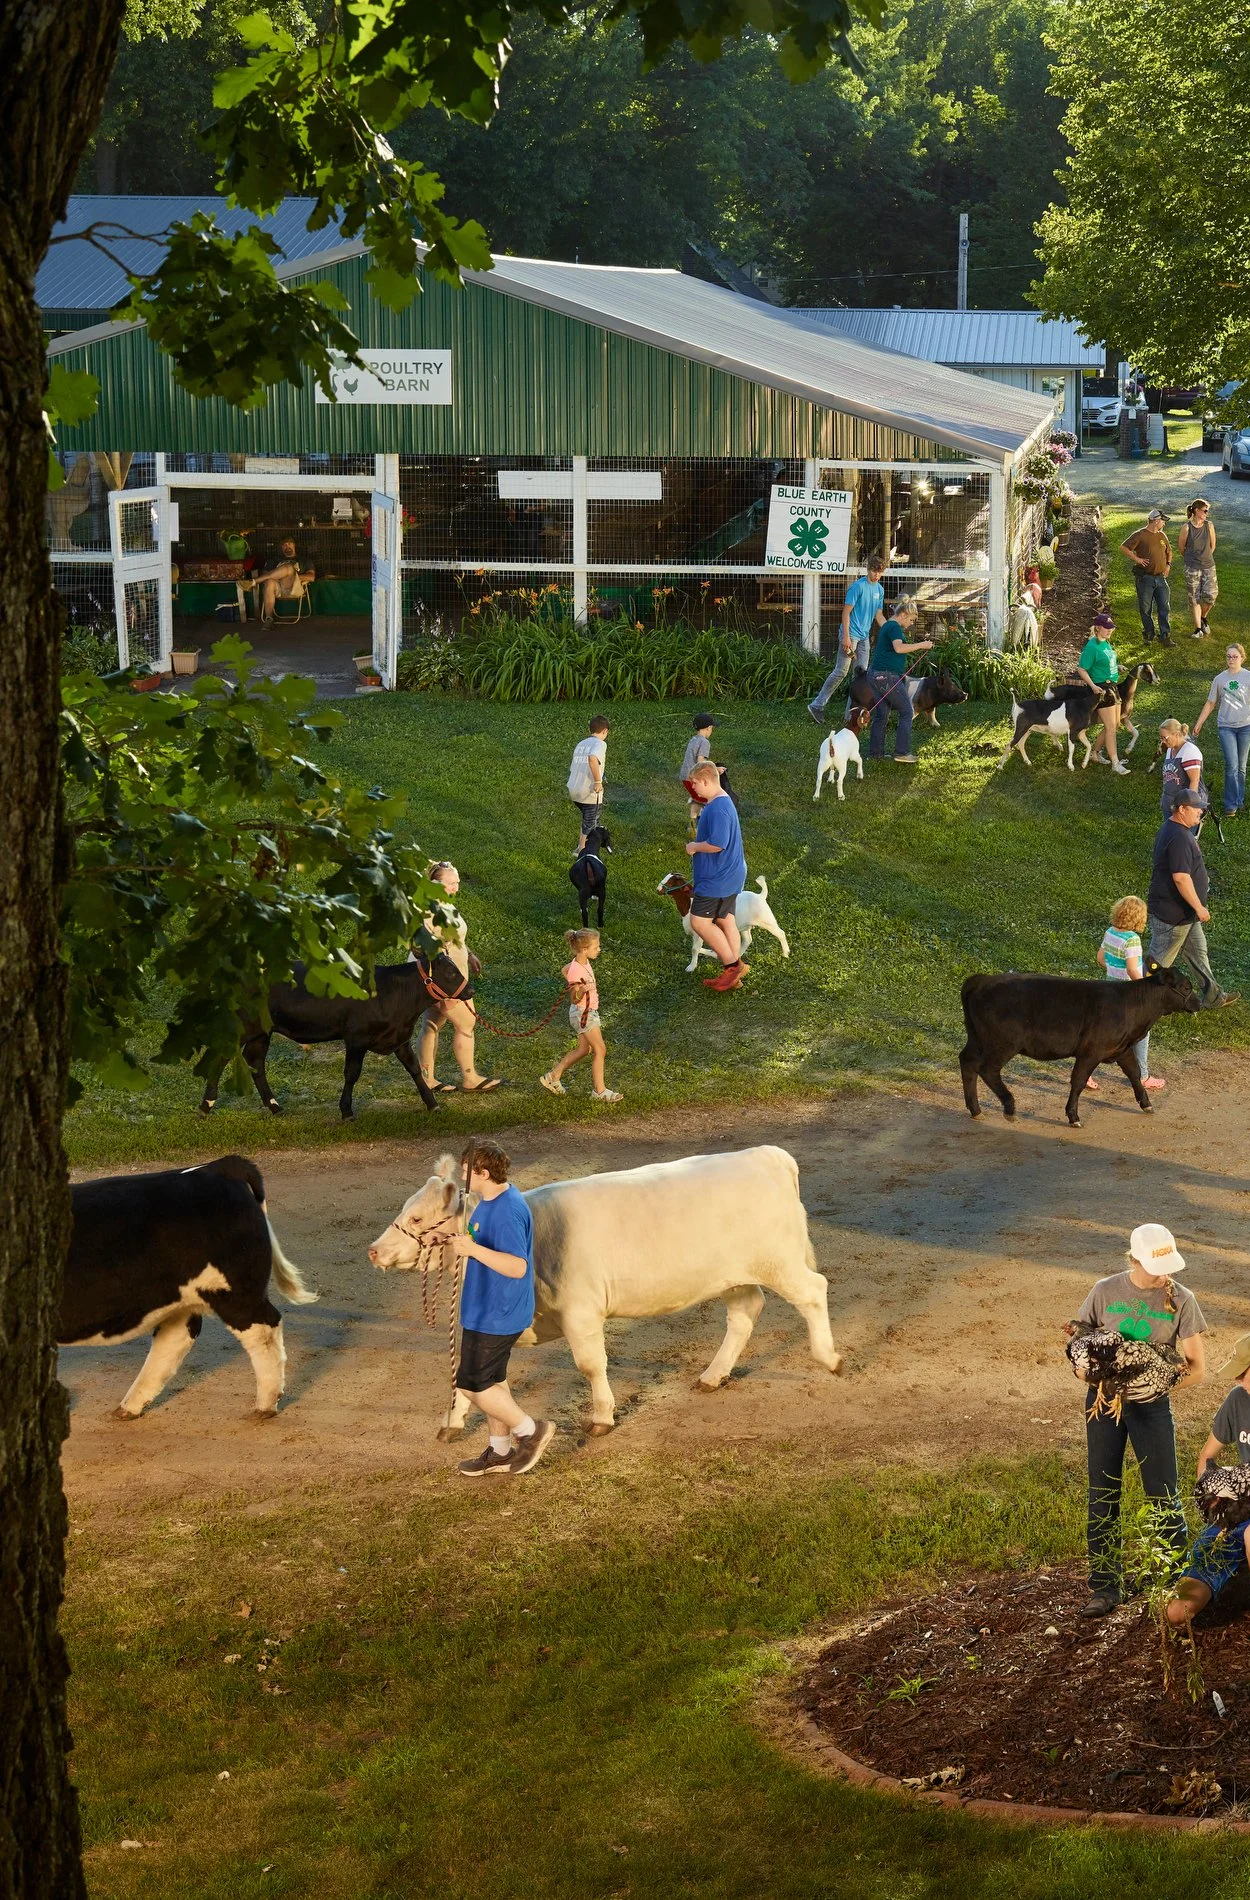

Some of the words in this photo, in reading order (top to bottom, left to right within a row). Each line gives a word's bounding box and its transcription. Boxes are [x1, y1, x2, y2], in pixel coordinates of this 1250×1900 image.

[369, 362, 443, 375] POULTRY
[385, 379, 430, 391] BARN
[777, 487, 805, 499] BLUE
[811, 490, 846, 503] EARTH
[790, 505, 831, 518] COUNTY
[767, 555, 823, 570] WELCOMES
[827, 561, 845, 572] YOU
